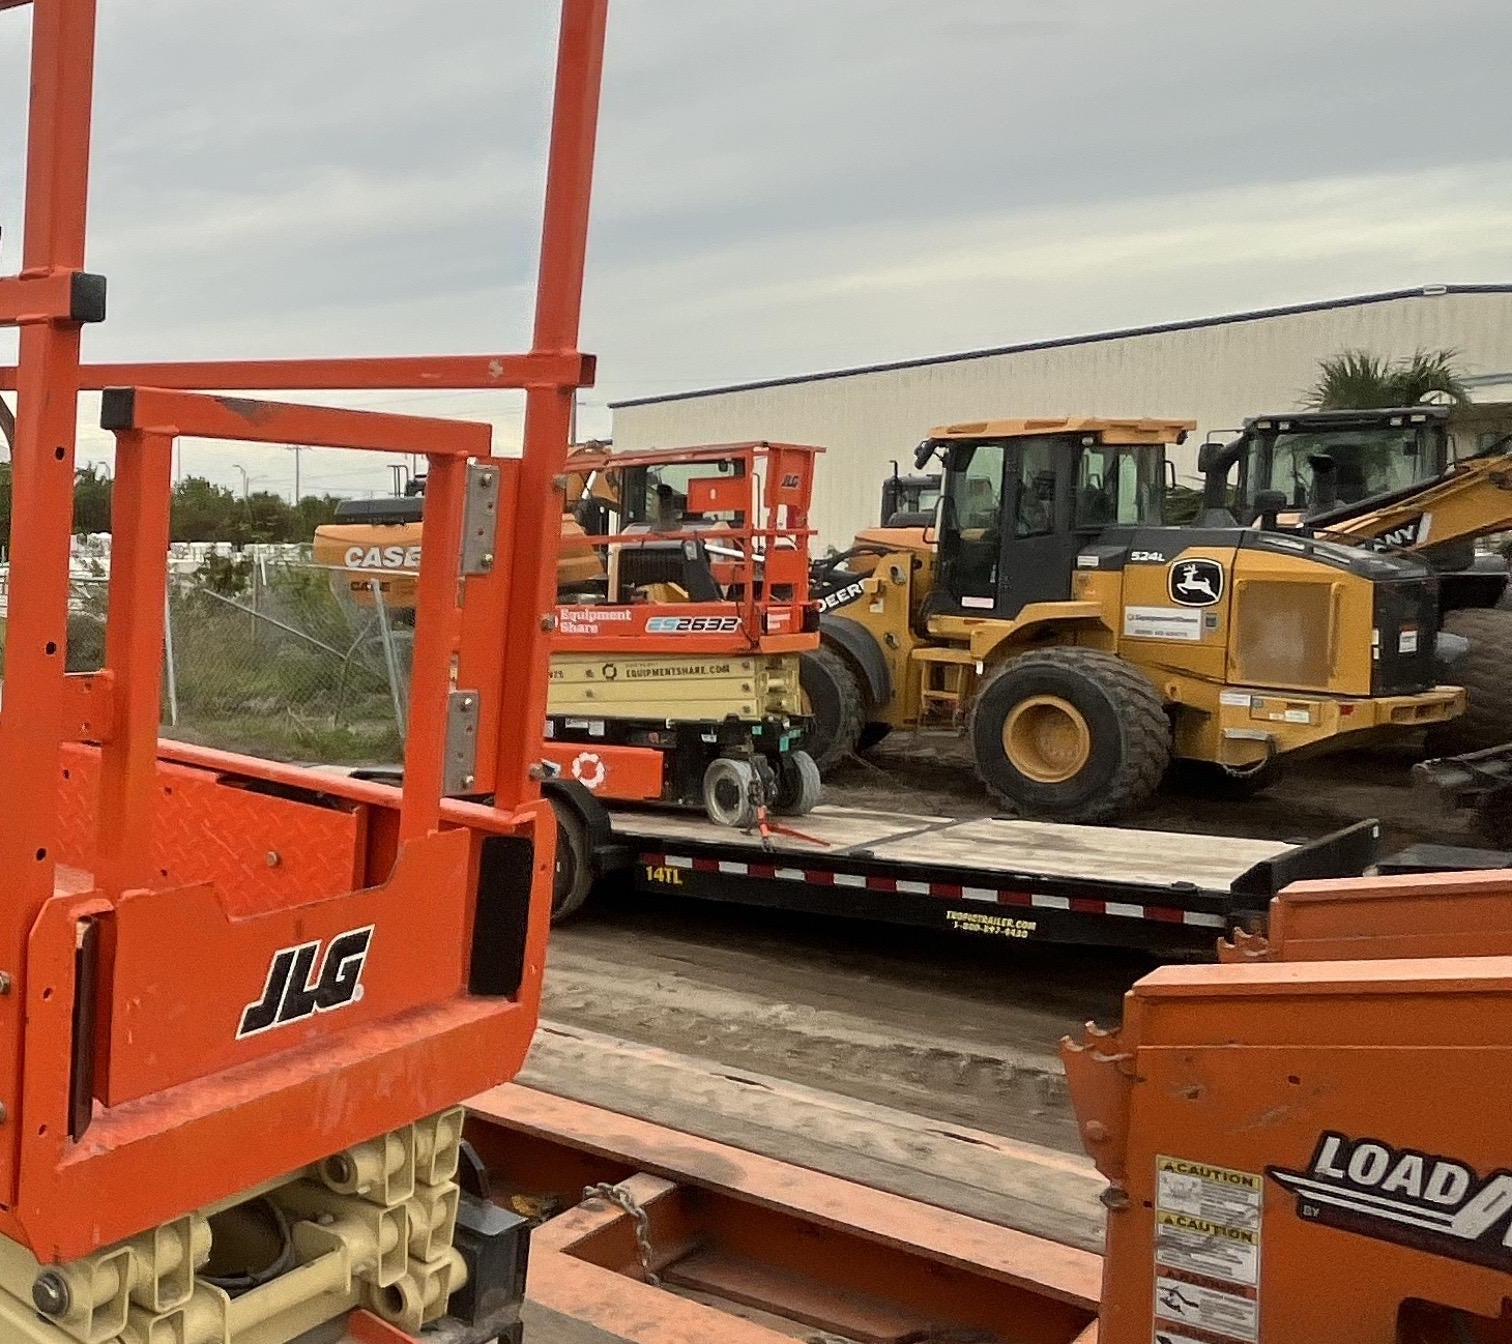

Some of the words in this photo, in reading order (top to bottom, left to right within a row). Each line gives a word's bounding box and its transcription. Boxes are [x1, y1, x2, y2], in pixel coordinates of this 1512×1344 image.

[344, 546, 422, 568] CASE
[1131, 551, 1165, 562] 524L
[350, 581, 391, 592] CAE
[818, 579, 868, 614] DEER
[560, 608, 633, 623] Equipment
[560, 621, 600, 634] Share
[647, 617, 739, 632] ES2632
[626, 664, 730, 678] EQUIPMENTSHARE.COM
[646, 866, 683, 885] 14TL
[237, 925, 374, 1039] JLG
[1176, 1163, 1254, 1188] CAUTION
[1303, 1205, 1320, 1218] BY
[1175, 1216, 1254, 1243] CAUTION
